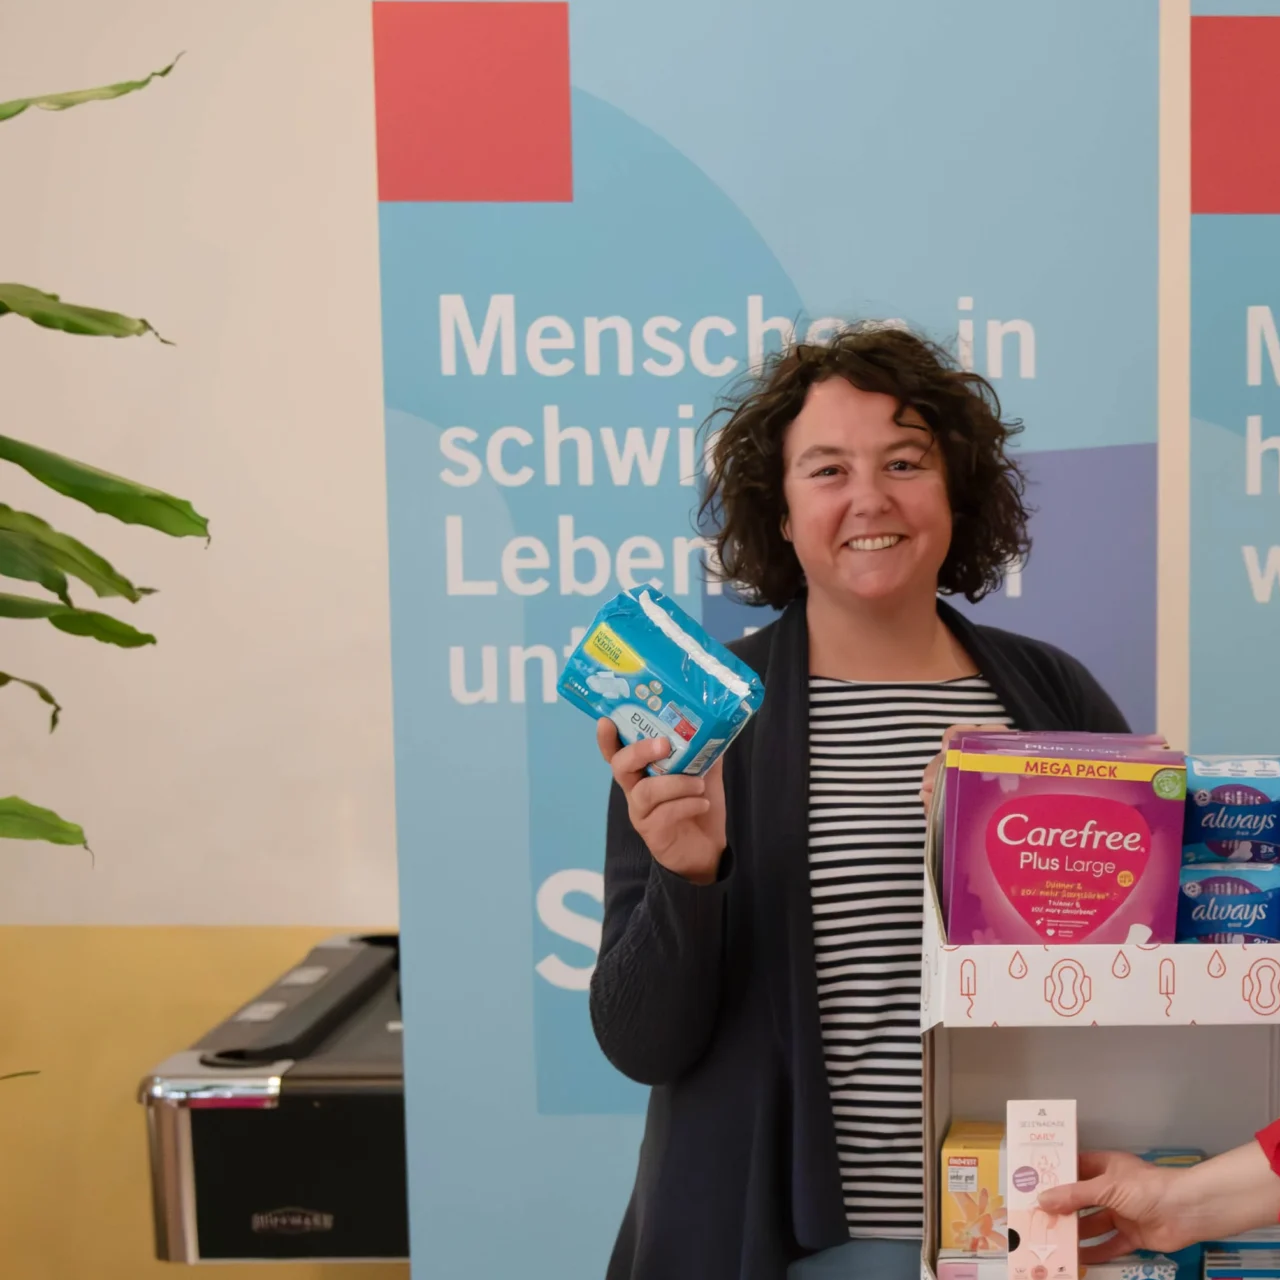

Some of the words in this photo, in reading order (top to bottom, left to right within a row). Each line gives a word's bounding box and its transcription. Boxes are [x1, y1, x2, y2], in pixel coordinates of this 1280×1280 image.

[439, 294, 909, 378] Mensch
[957, 297, 1036, 379] in
[439, 405, 724, 487] schwi
[1024, 761, 1072, 776] MEGA
[1076, 764, 1118, 779] PACK
[997, 813, 1142, 852] Carefree
[1201, 806, 1277, 836] always
[1020, 851, 1060, 871] Plus
[1065, 855, 1116, 878] Large
[1192, 897, 1268, 928] always
